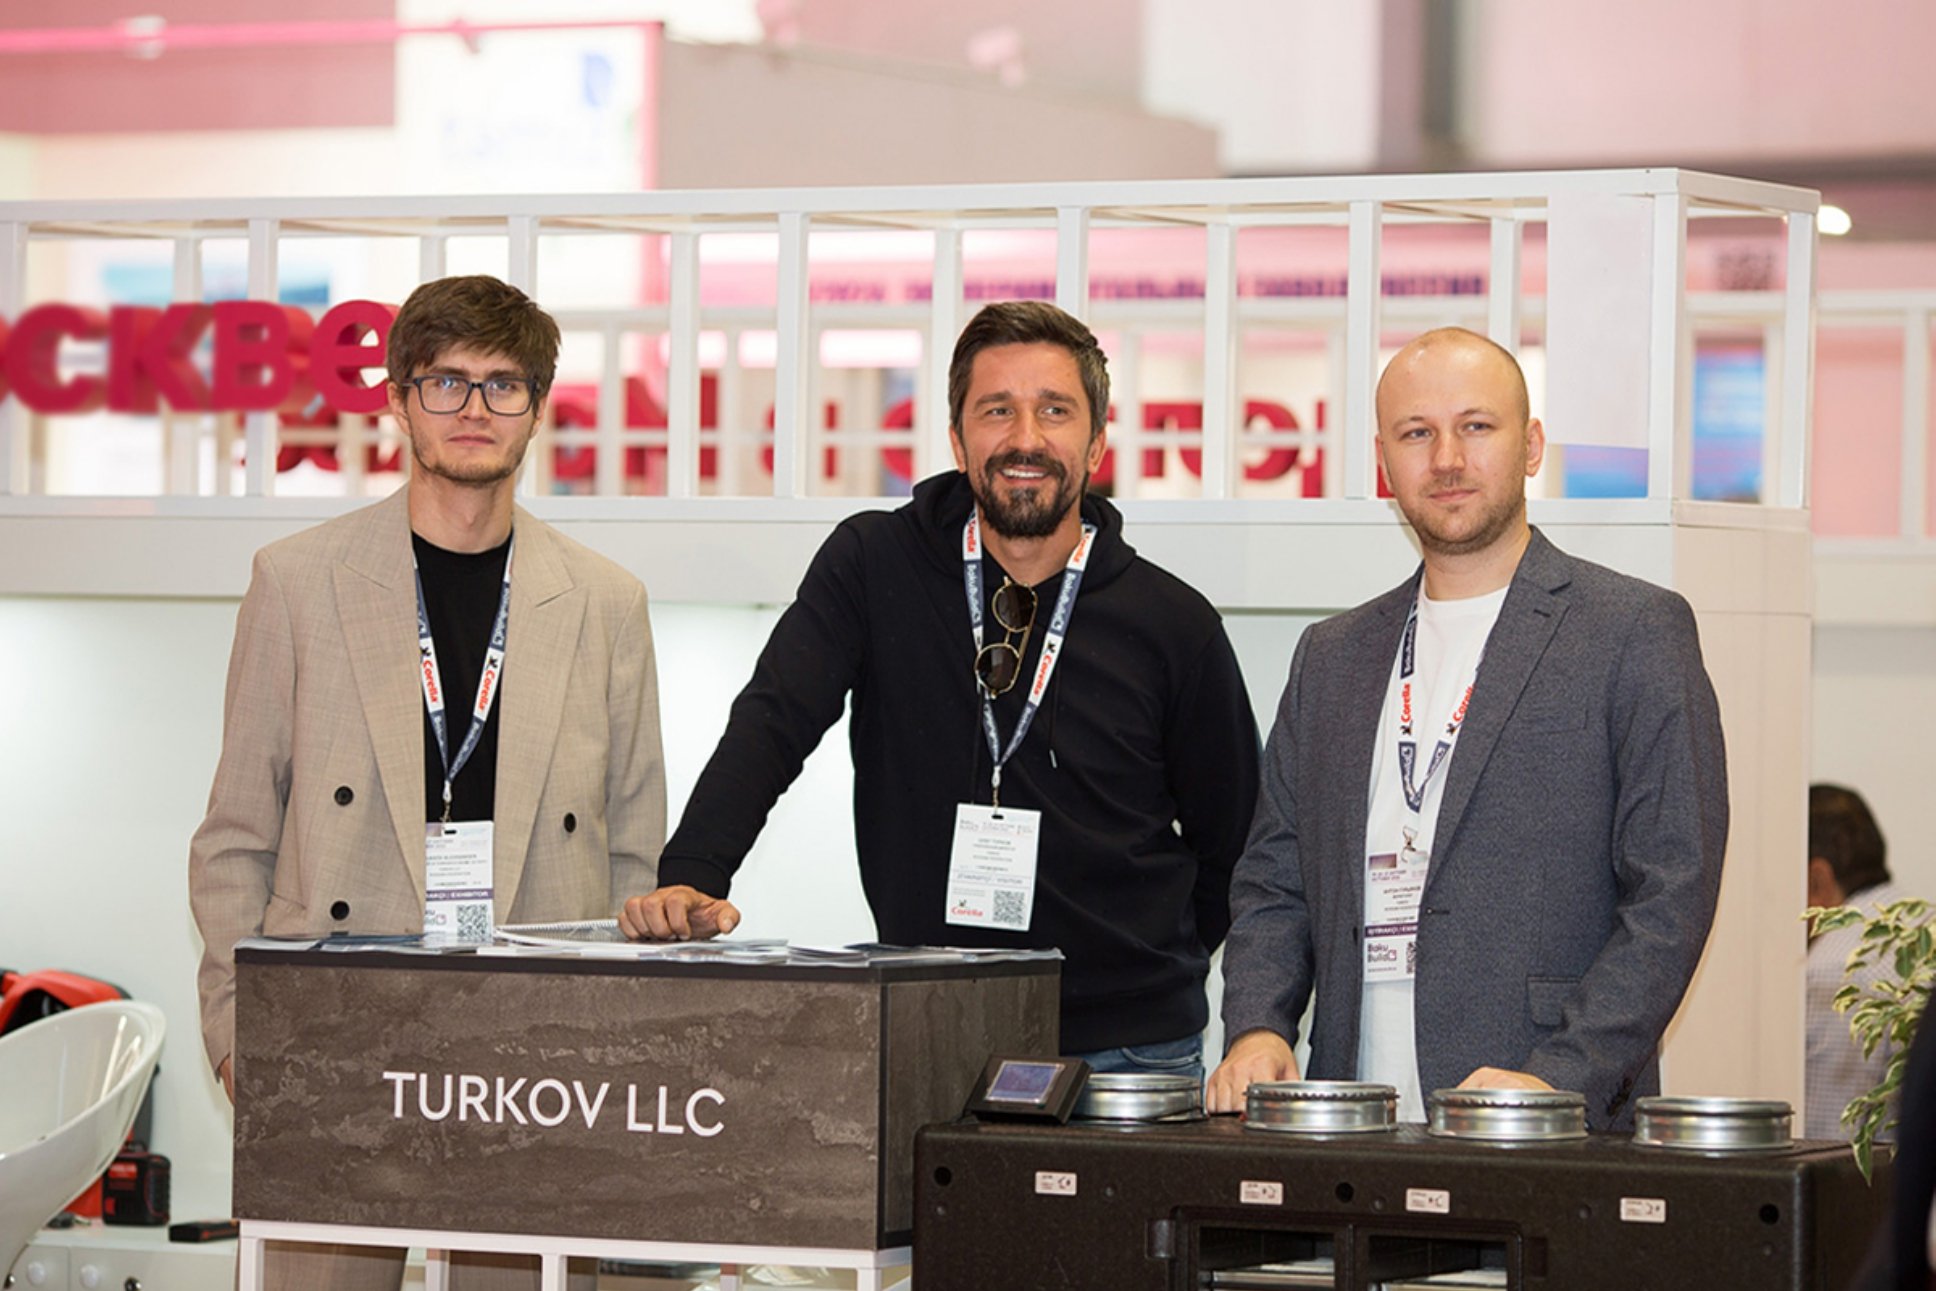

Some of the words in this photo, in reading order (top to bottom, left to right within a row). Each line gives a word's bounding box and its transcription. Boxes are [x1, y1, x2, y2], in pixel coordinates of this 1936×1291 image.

[422, 660, 438, 703] Corella
[479, 669, 496, 711] Corella
[1033, 654, 1052, 696] Corella
[1400, 683, 1411, 723] Corella
[1452, 685, 1475, 722] Corell
[383, 1071, 610, 1129] TURKOV
[627, 1084, 726, 1137] LLC
